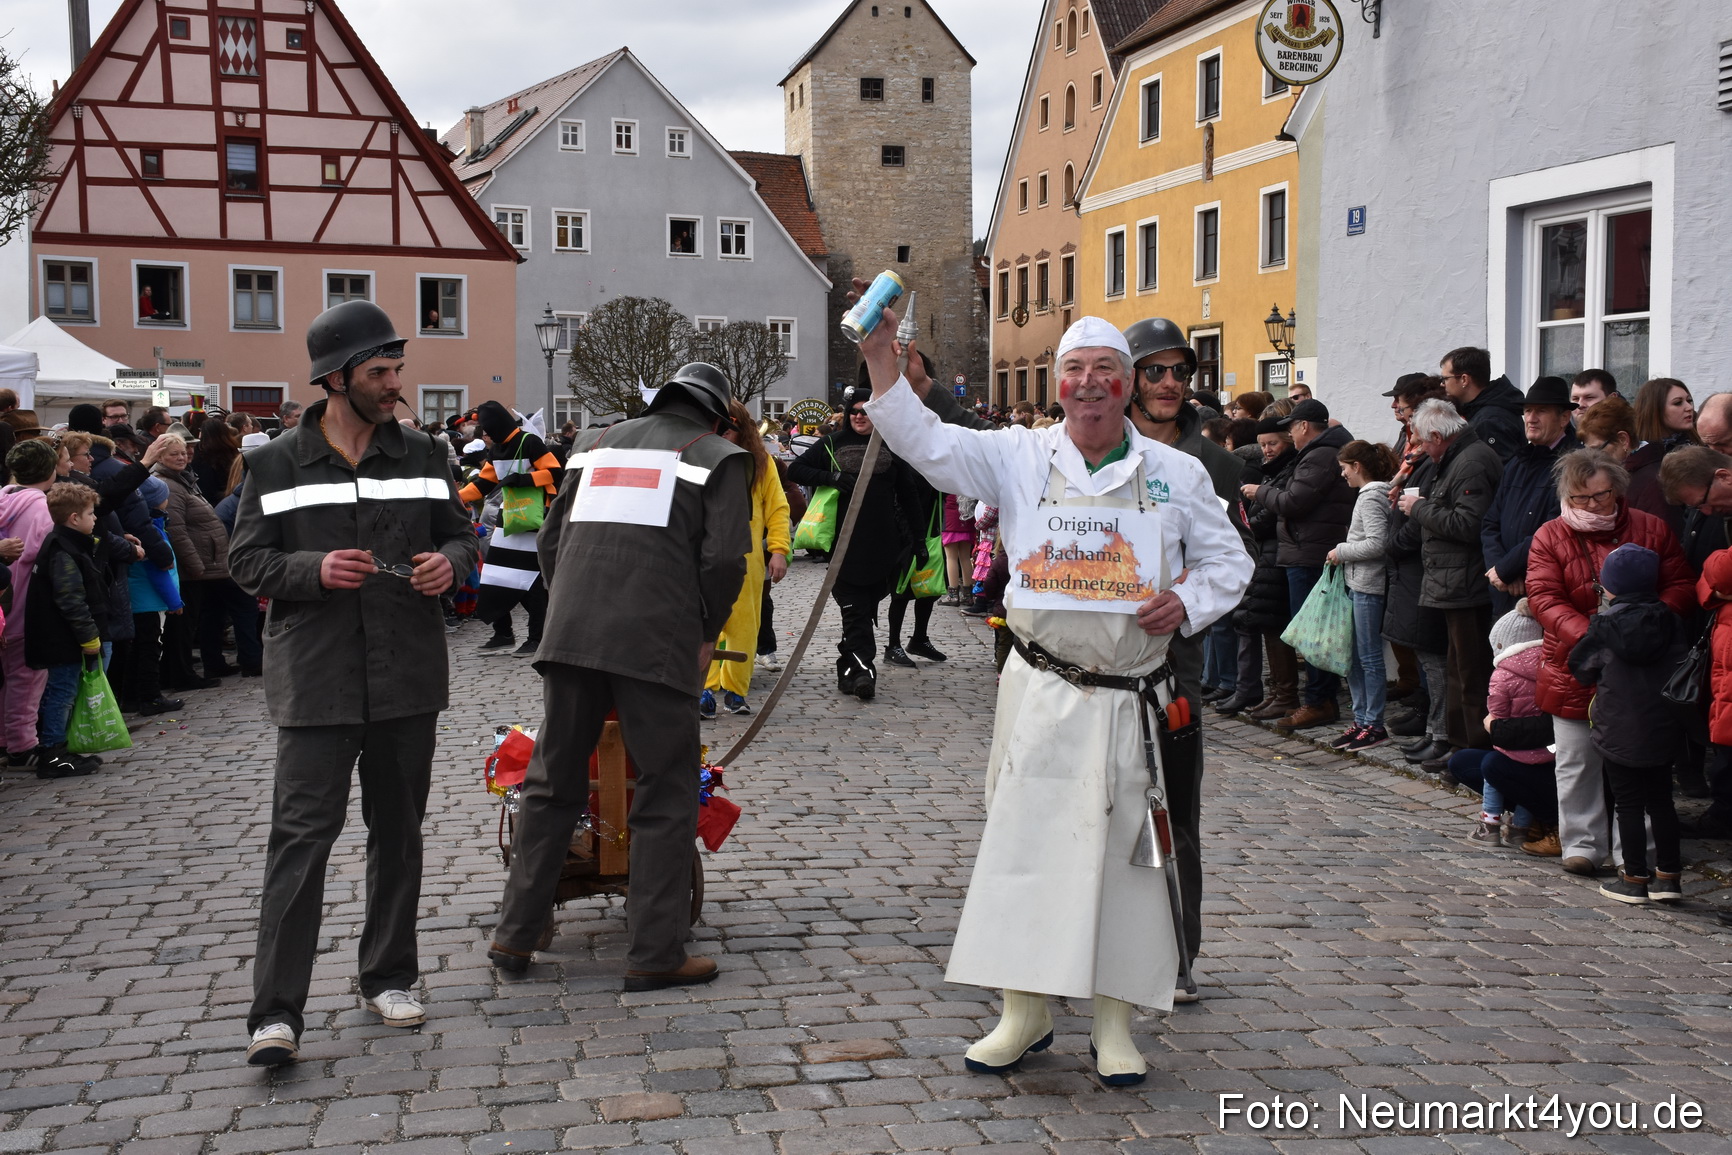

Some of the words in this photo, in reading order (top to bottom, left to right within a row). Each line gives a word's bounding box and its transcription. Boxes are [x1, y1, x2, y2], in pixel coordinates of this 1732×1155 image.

[1279, 61, 1318, 73] BERCHING
[1352, 210, 1360, 223] 19
[166, 360, 202, 368] Probststraße
[1271, 365, 1285, 375] BW
[119, 370, 156, 378] Forstergasse
[790, 401, 832, 417] Blaskapelle
[798, 410, 824, 422] Pilsach
[1048, 516, 1119, 536] Original
[1044, 545, 1121, 563] Bachama
[1020, 574, 1143, 597] Brandmetzger
